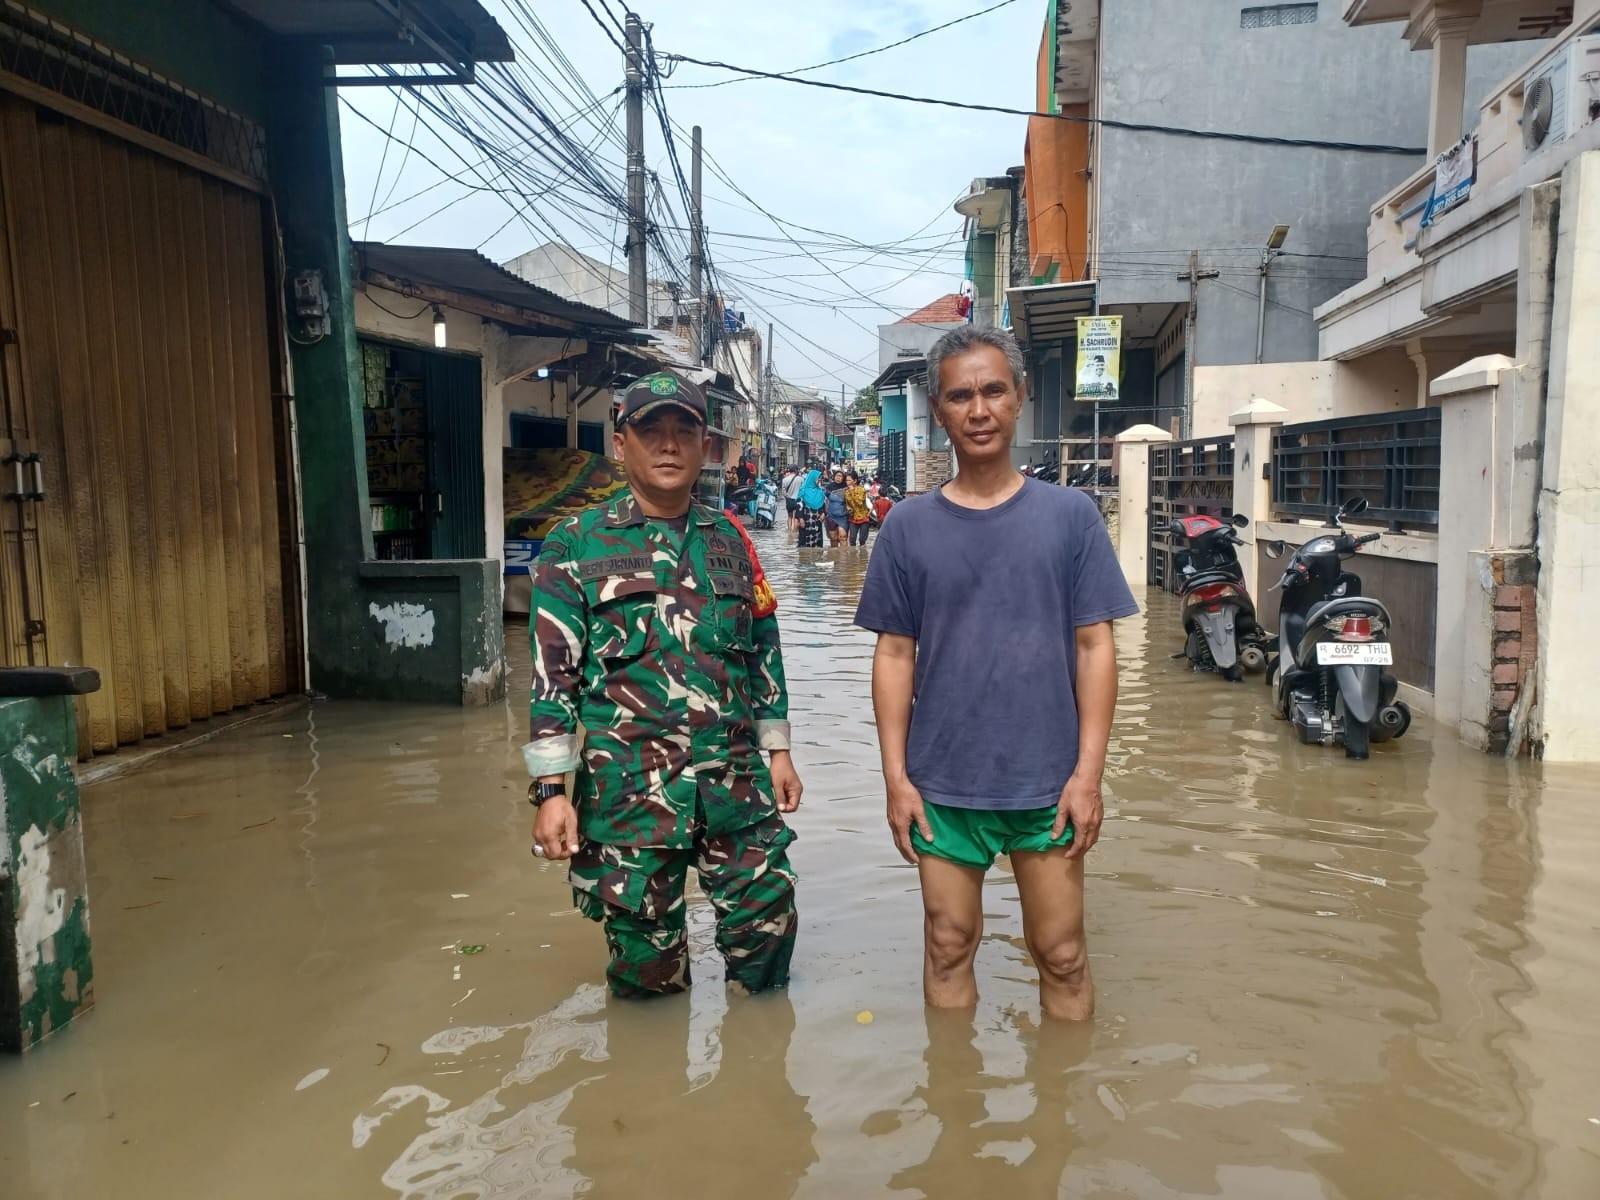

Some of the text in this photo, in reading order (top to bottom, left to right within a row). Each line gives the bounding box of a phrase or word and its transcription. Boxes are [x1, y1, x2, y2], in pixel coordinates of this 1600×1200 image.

[607, 556, 653, 572] SURYANTO
[706, 556, 733, 569] TNI
[1334, 644, 1360, 654] 6692
[1367, 644, 1389, 654] THU
